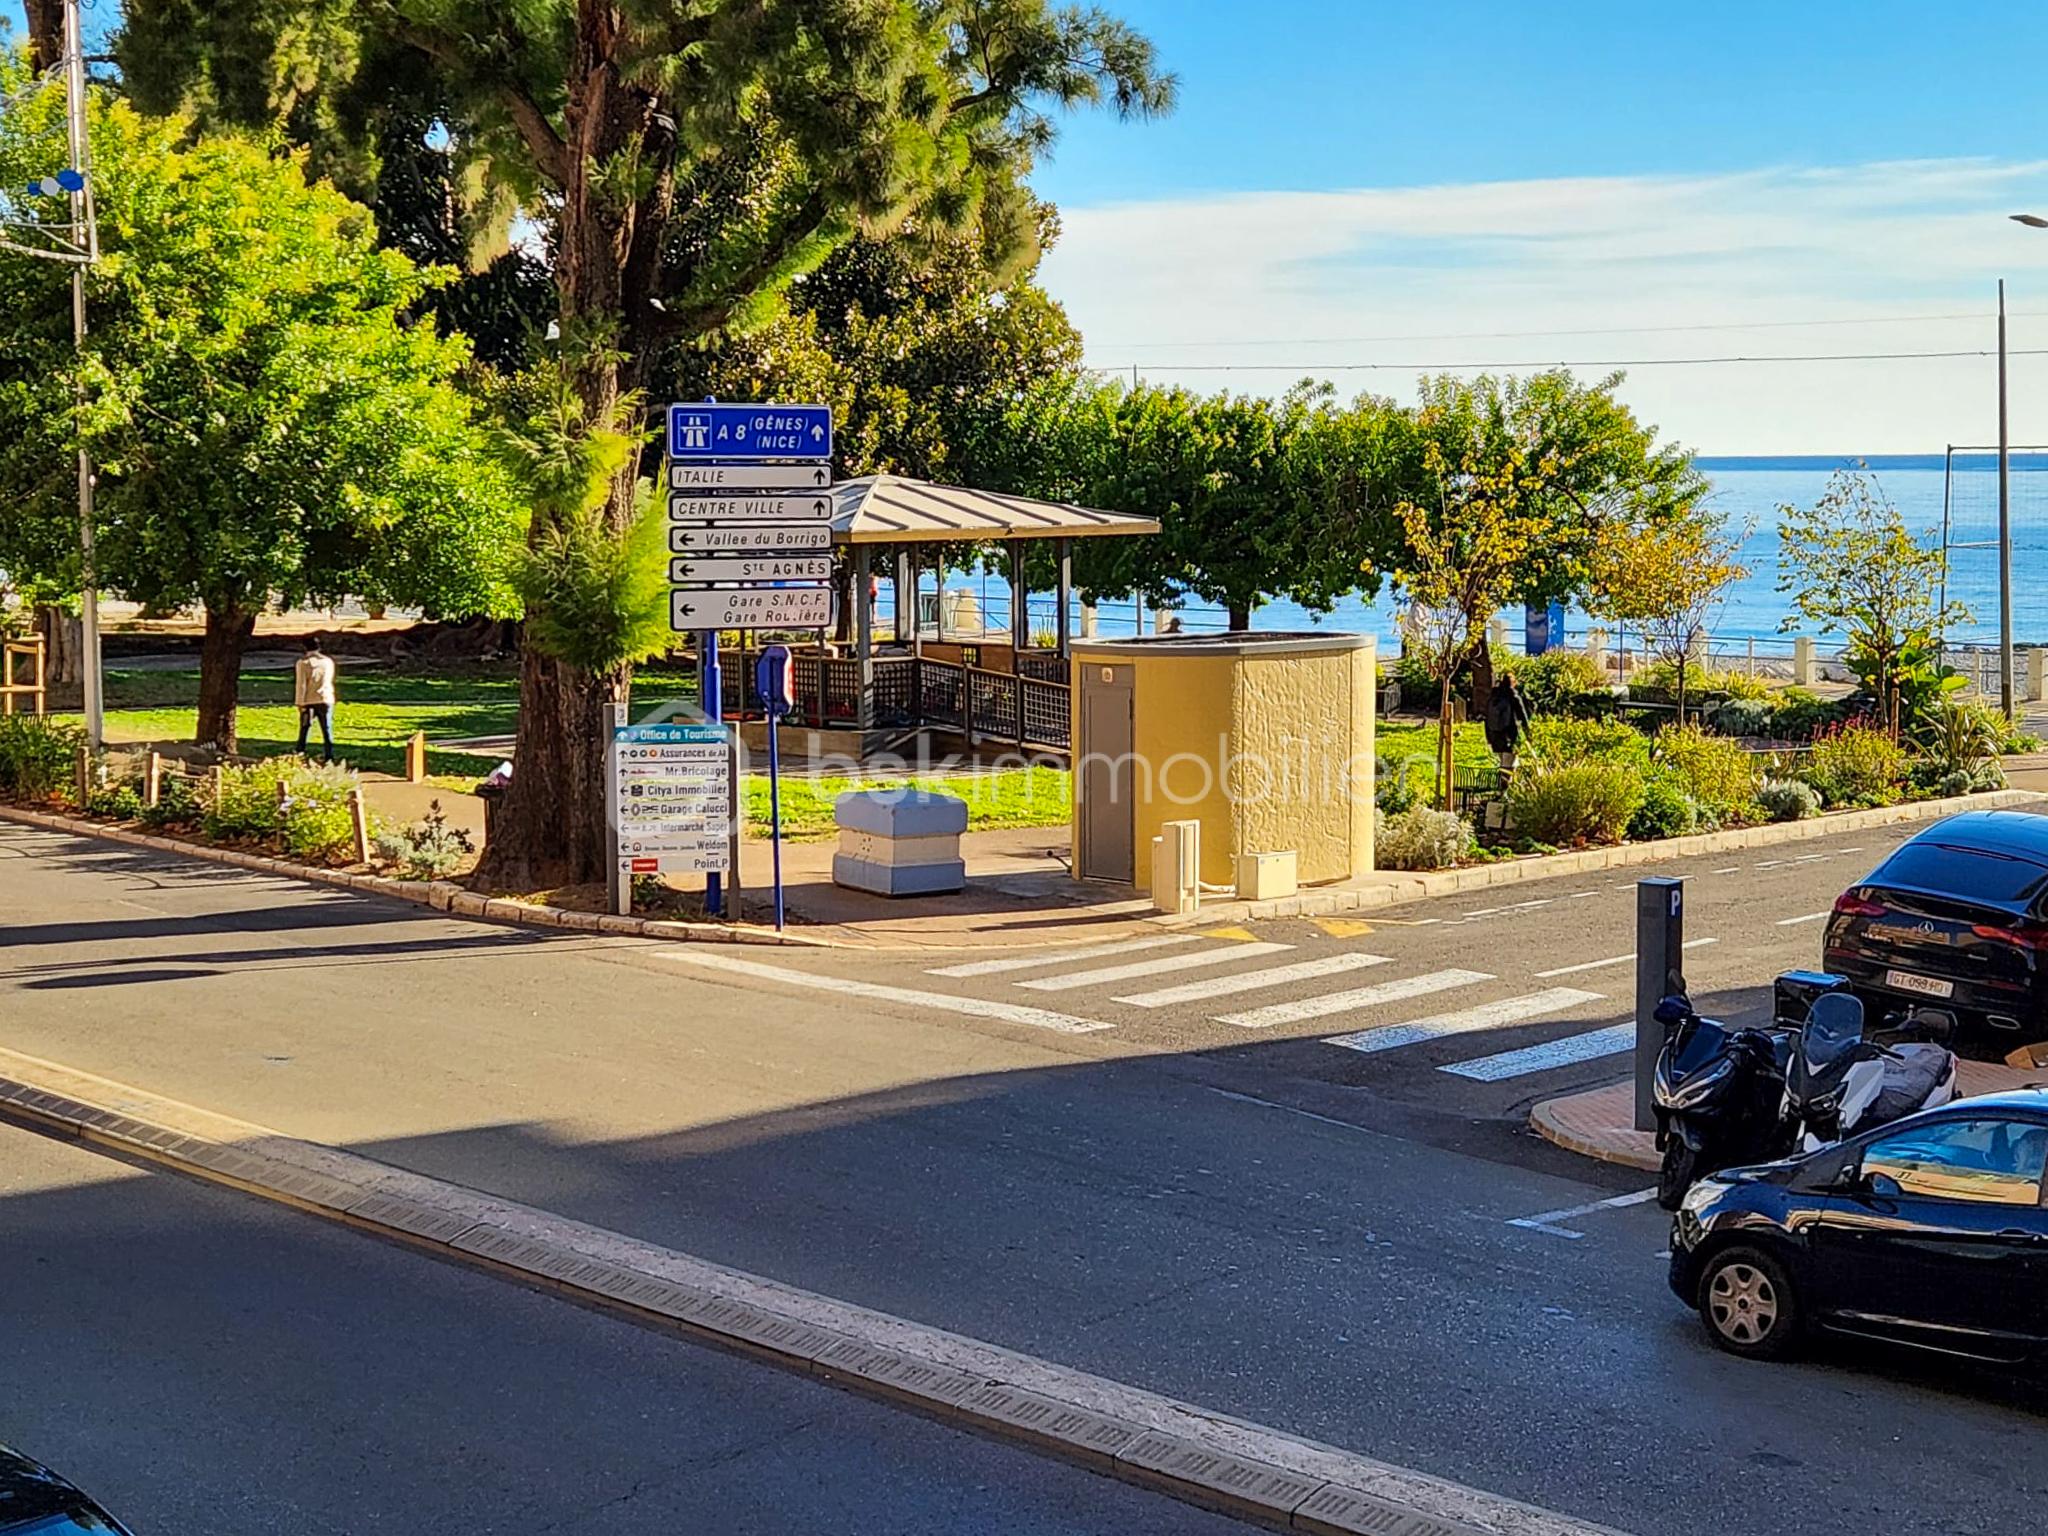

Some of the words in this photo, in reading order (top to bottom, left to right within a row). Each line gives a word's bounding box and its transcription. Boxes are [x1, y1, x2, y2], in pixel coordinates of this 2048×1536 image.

[717, 424, 729, 440] A
[735, 424, 746, 441] 8
[756, 435, 802, 449] (NICE)
[677, 470, 725, 484] ITALIE
[678, 501, 737, 515] CENTRE
[745, 501, 784, 514] VILLE
[705, 533, 748, 545] Vallee
[754, 532, 771, 545] du
[776, 531, 827, 547] Borrigo
[729, 595, 763, 608] Gare
[723, 611, 757, 624] Gare
[640, 730, 668, 740] Office
[669, 729, 682, 739] de
[684, 729, 727, 739] Tourisme
[660, 748, 706, 758] Assurances
[648, 786, 672, 797] Citya
[675, 785, 727, 794] Immobilier
[661, 804, 692, 815] Garage
[707, 821, 728, 832] Super
[696, 840, 728, 850] Weldom
[1671, 890, 1681, 916] P
